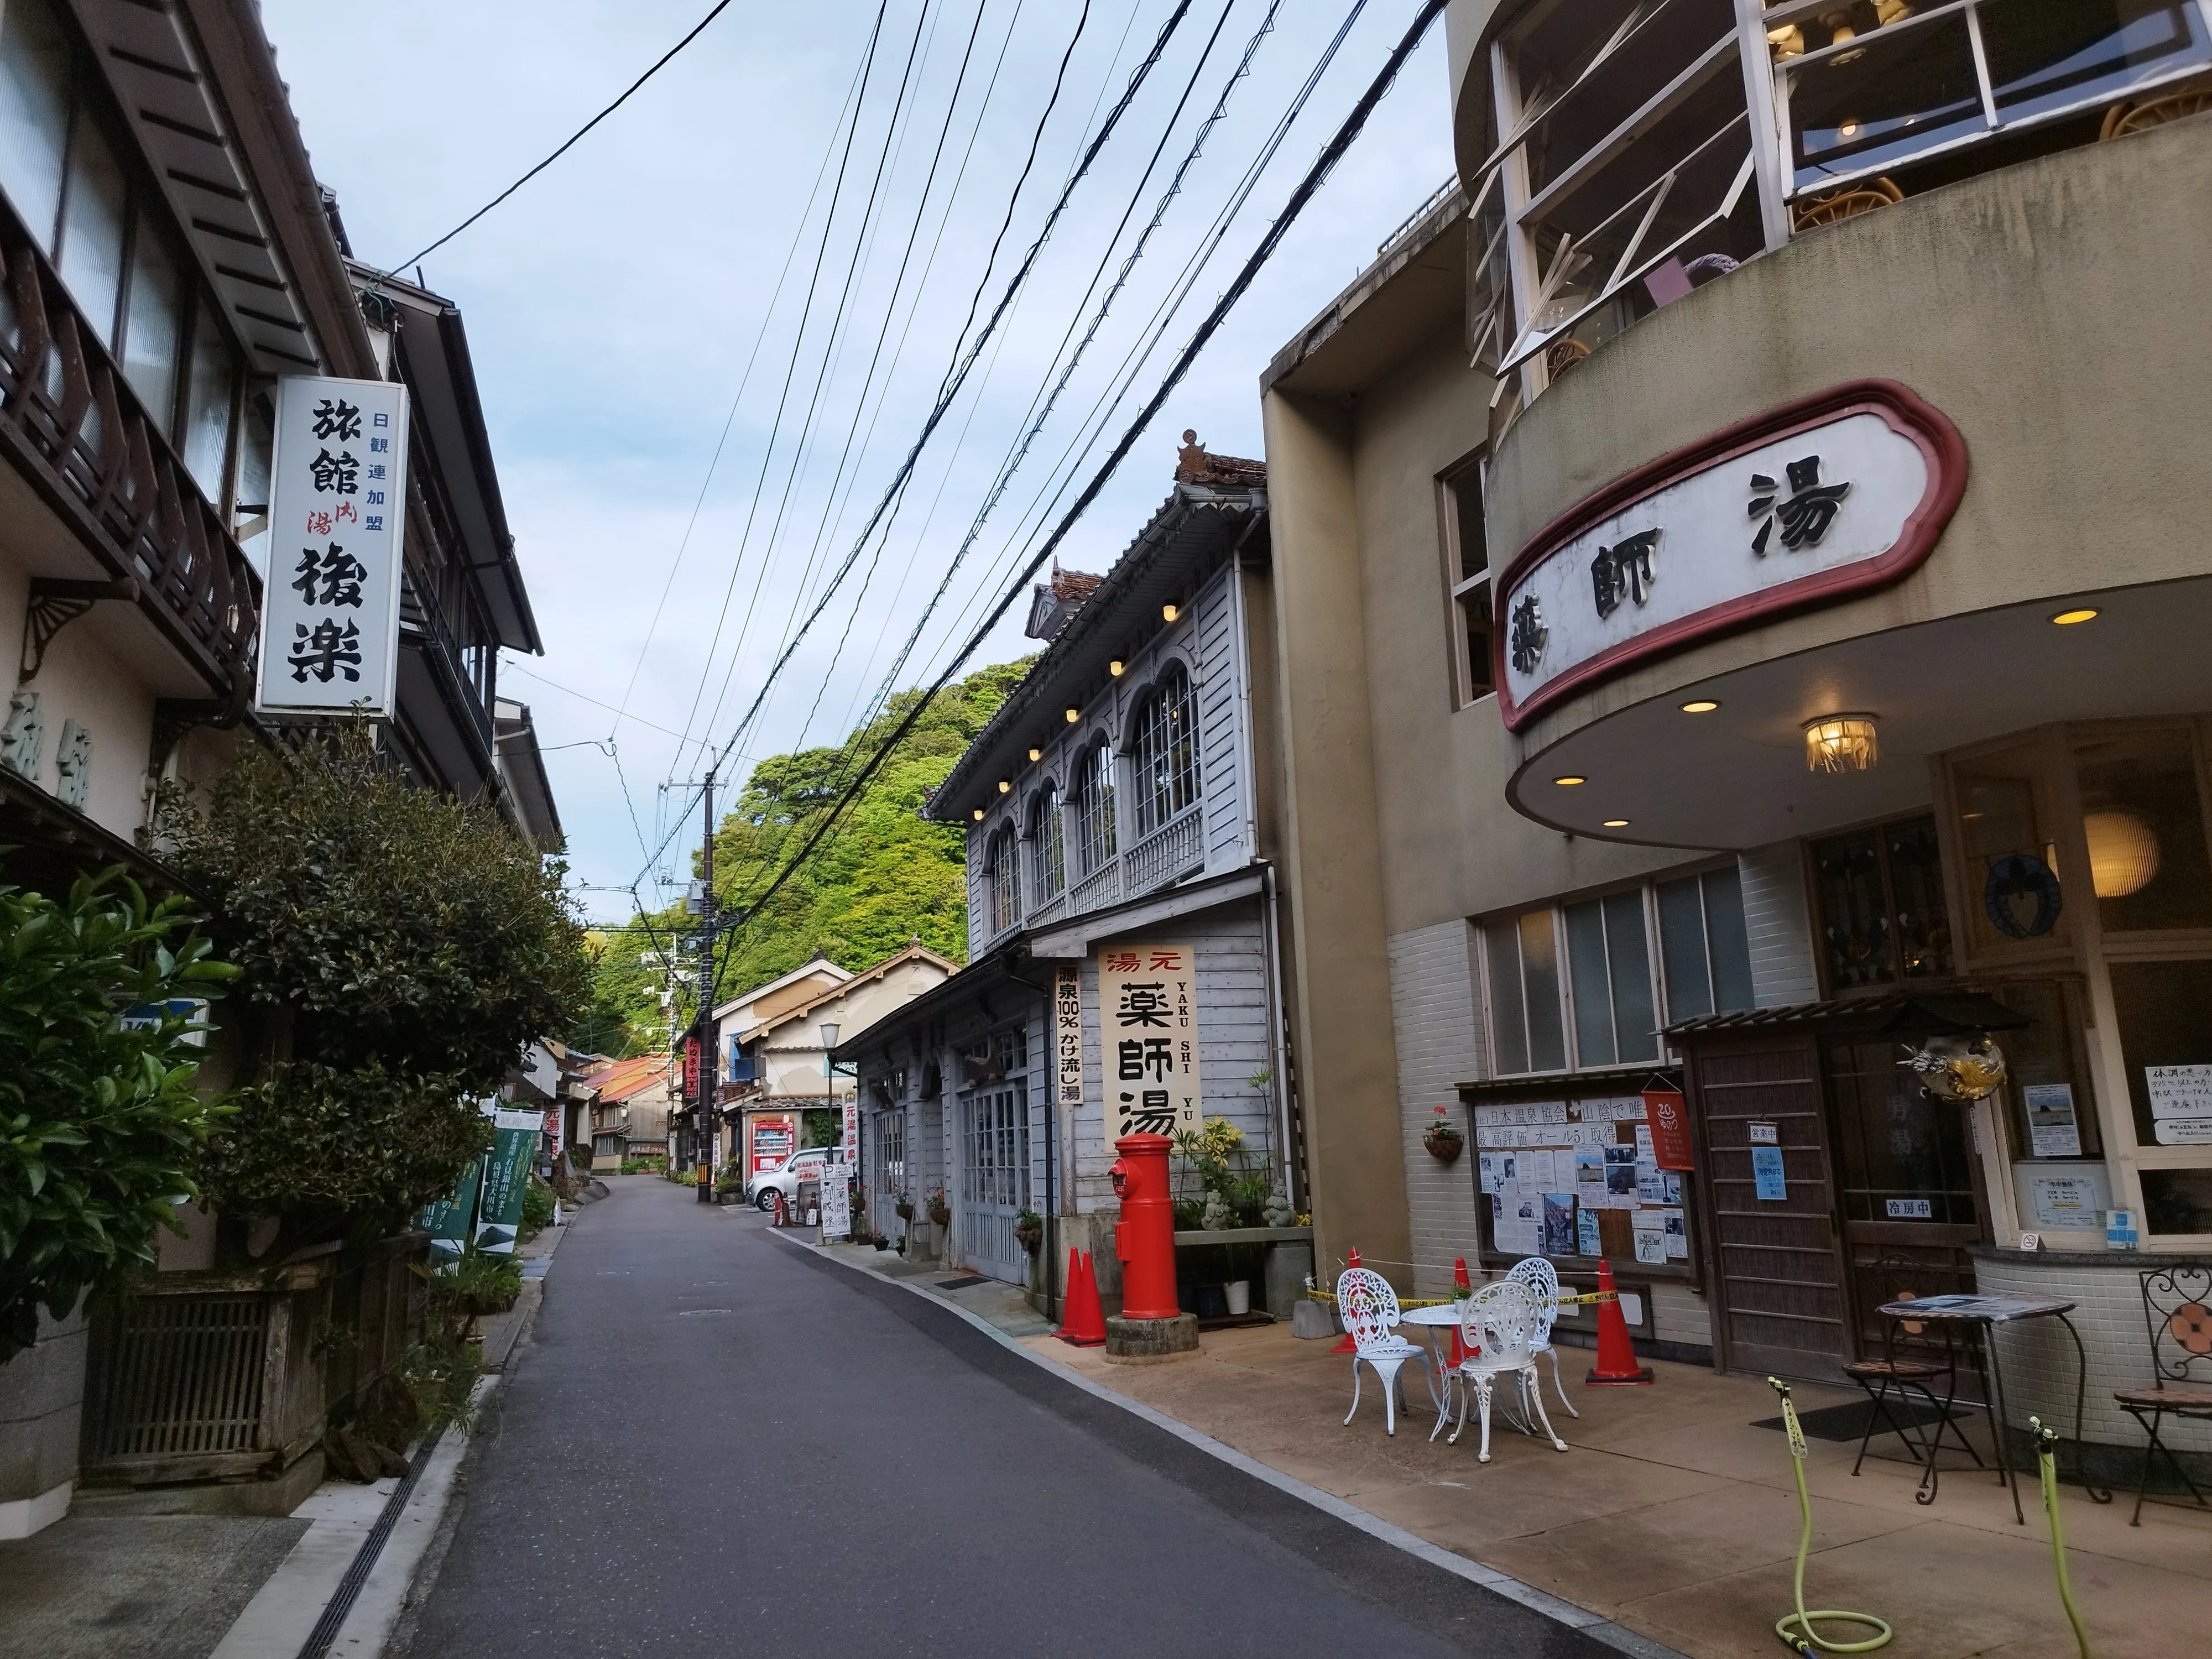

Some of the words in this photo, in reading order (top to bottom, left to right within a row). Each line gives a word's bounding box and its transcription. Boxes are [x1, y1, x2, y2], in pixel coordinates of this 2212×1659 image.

[310, 398, 363, 495] 旅館
[364, 413, 389, 531] 日観連加盟
[286, 541, 368, 684] 後楽
[1176, 982, 1190, 1028] YAKU
[1115, 981, 1178, 1136] 薬師湯
[1180, 1040, 1192, 1074] SHI
[1182, 1097, 1194, 1121] YU
[1582, 1100, 1647, 1121] 山陰で唯
[846, 1105, 856, 1160] 元湯温泉
[1752, 1128, 1775, 1139] 営業中
[836, 1187, 848, 1227] 薬師湯
[1888, 1201, 1929, 1215] 冷房中
